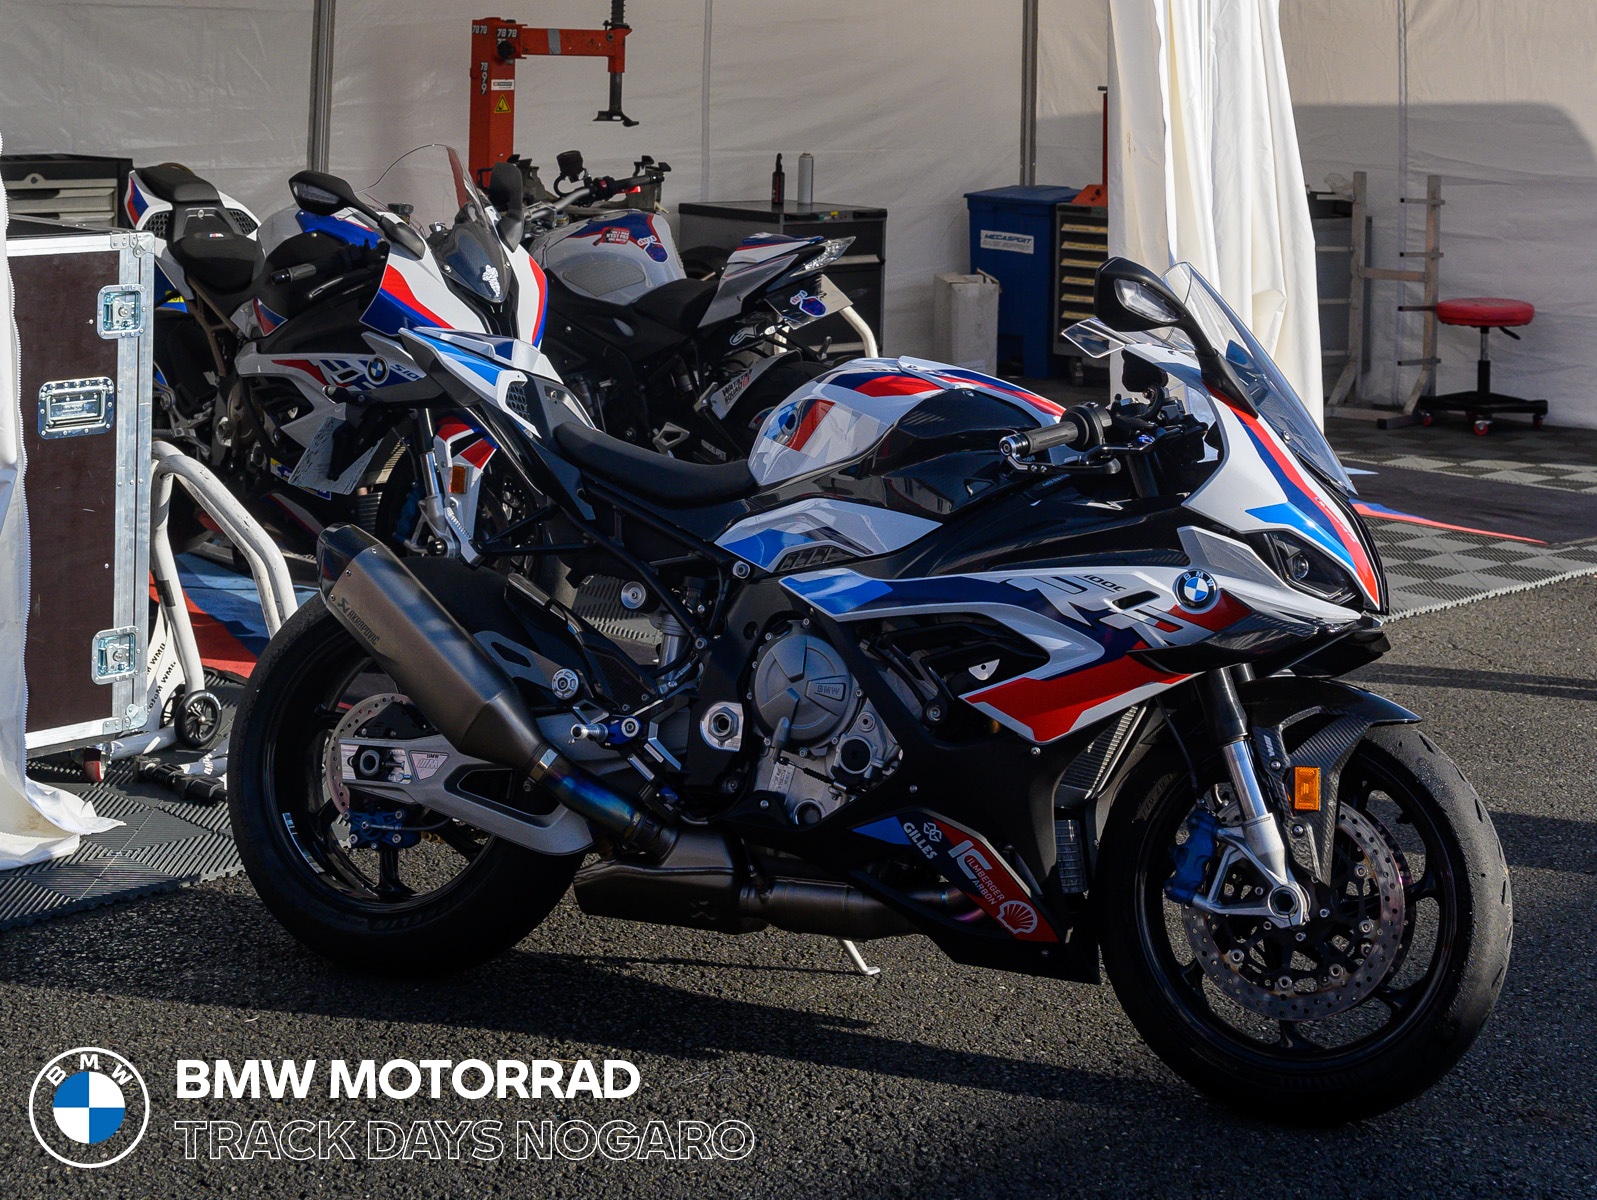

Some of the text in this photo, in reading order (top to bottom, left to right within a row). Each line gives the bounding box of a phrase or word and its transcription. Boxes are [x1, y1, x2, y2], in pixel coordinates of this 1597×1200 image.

[497, 28, 517, 38] 78 78
[817, 684, 841, 696] BMW
[903, 822, 938, 860] GILLES
[966, 858, 1005, 901] ILMBERGER
[972, 879, 997, 905] ARBON
